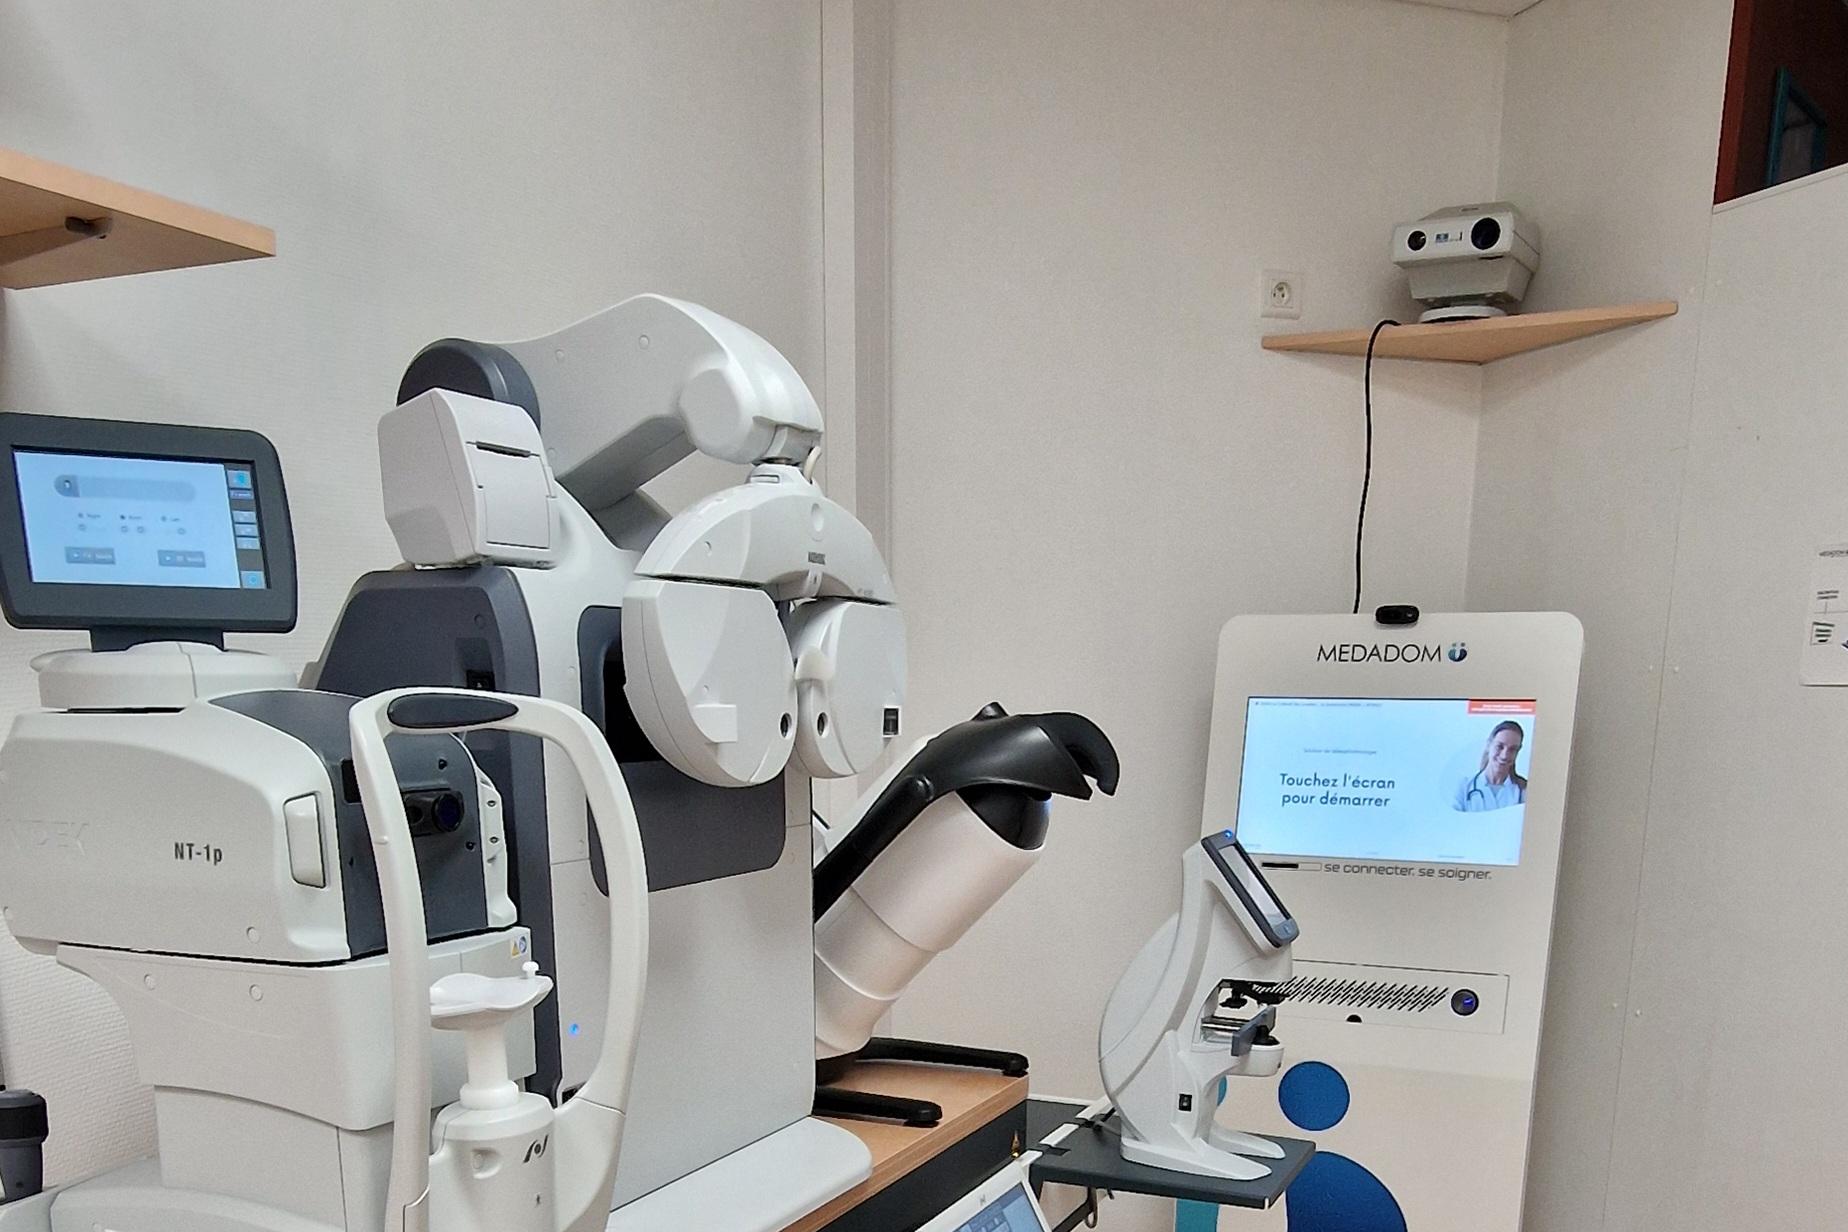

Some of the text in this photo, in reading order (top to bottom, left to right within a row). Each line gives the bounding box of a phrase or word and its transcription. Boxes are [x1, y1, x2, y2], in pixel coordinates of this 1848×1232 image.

[1316, 643, 1442, 663] MEDADOM
[1280, 772, 1396, 789] Touchez l'écran
[1282, 790, 1391, 807] pour démarrer
[174, 841, 223, 866] NT-1p
[1323, 863, 1341, 873] se
[1418, 867, 1436, 878] se
